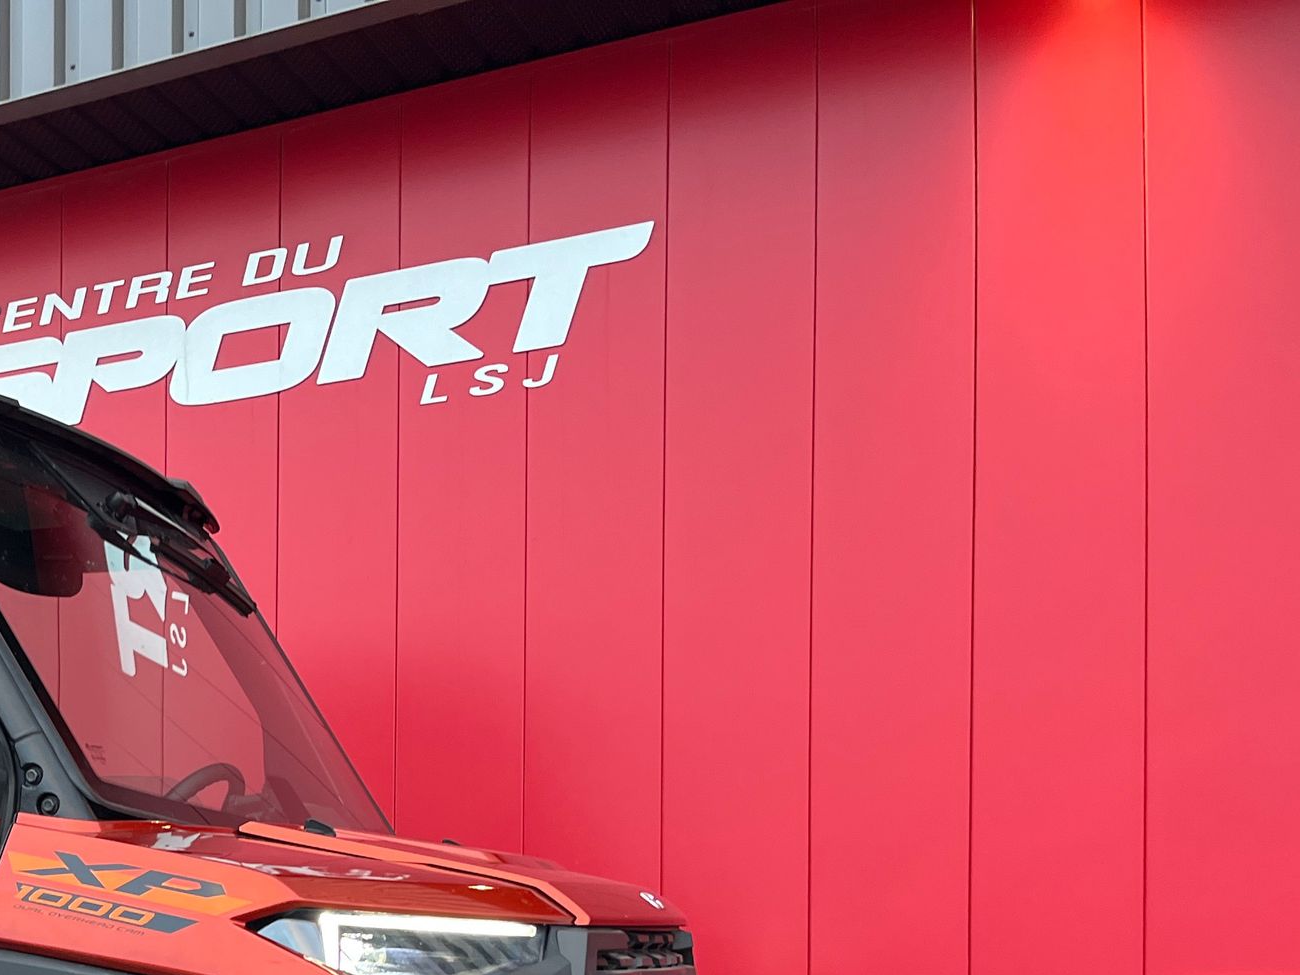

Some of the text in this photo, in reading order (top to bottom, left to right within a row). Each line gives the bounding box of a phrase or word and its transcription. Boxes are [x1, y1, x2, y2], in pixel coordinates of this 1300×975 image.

[241, 234, 345, 288] DU
[19, 850, 227, 898] XP
[15, 884, 156, 927] 1000
